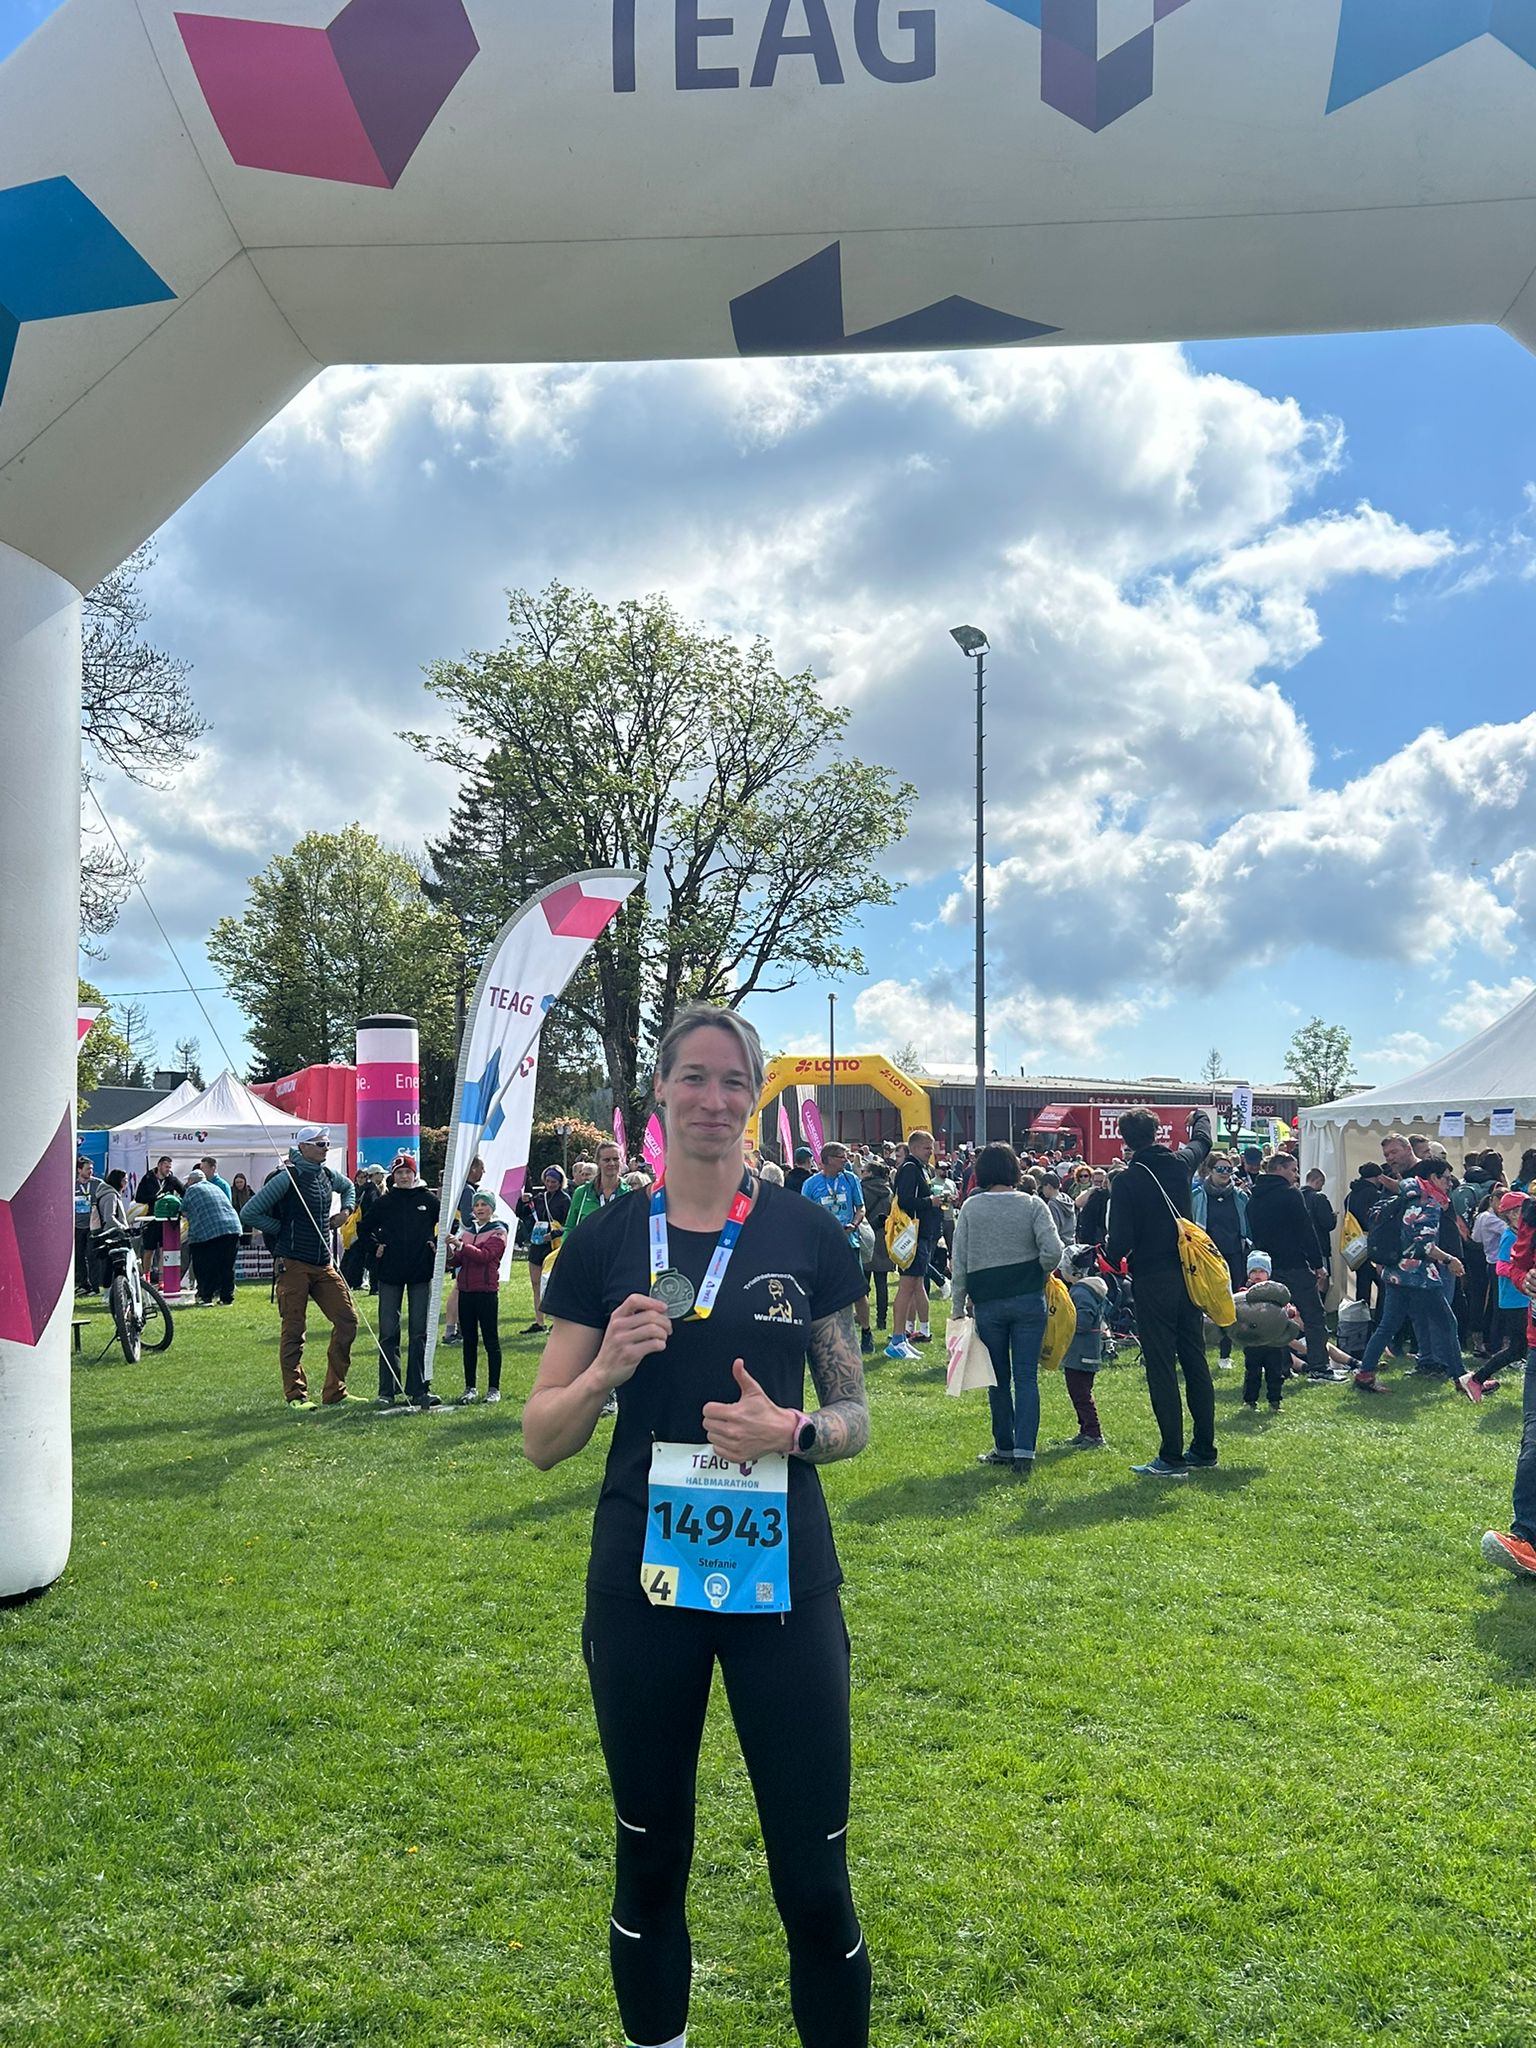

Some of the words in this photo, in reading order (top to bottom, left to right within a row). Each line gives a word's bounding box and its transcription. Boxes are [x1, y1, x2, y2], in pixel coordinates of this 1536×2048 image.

[489, 985, 535, 1016] TEAG
[815, 1059, 861, 1072] LOTTO
[889, 1075, 913, 1097] LOTTO
[173, 1133, 193, 1141] TEAG
[692, 1454, 730, 1470] TEAG
[686, 1476, 760, 1489] HALBMARATHON
[653, 1501, 783, 1549] 14943
[698, 1557, 737, 1569] Stefanie
[650, 1569, 671, 1601] 4
